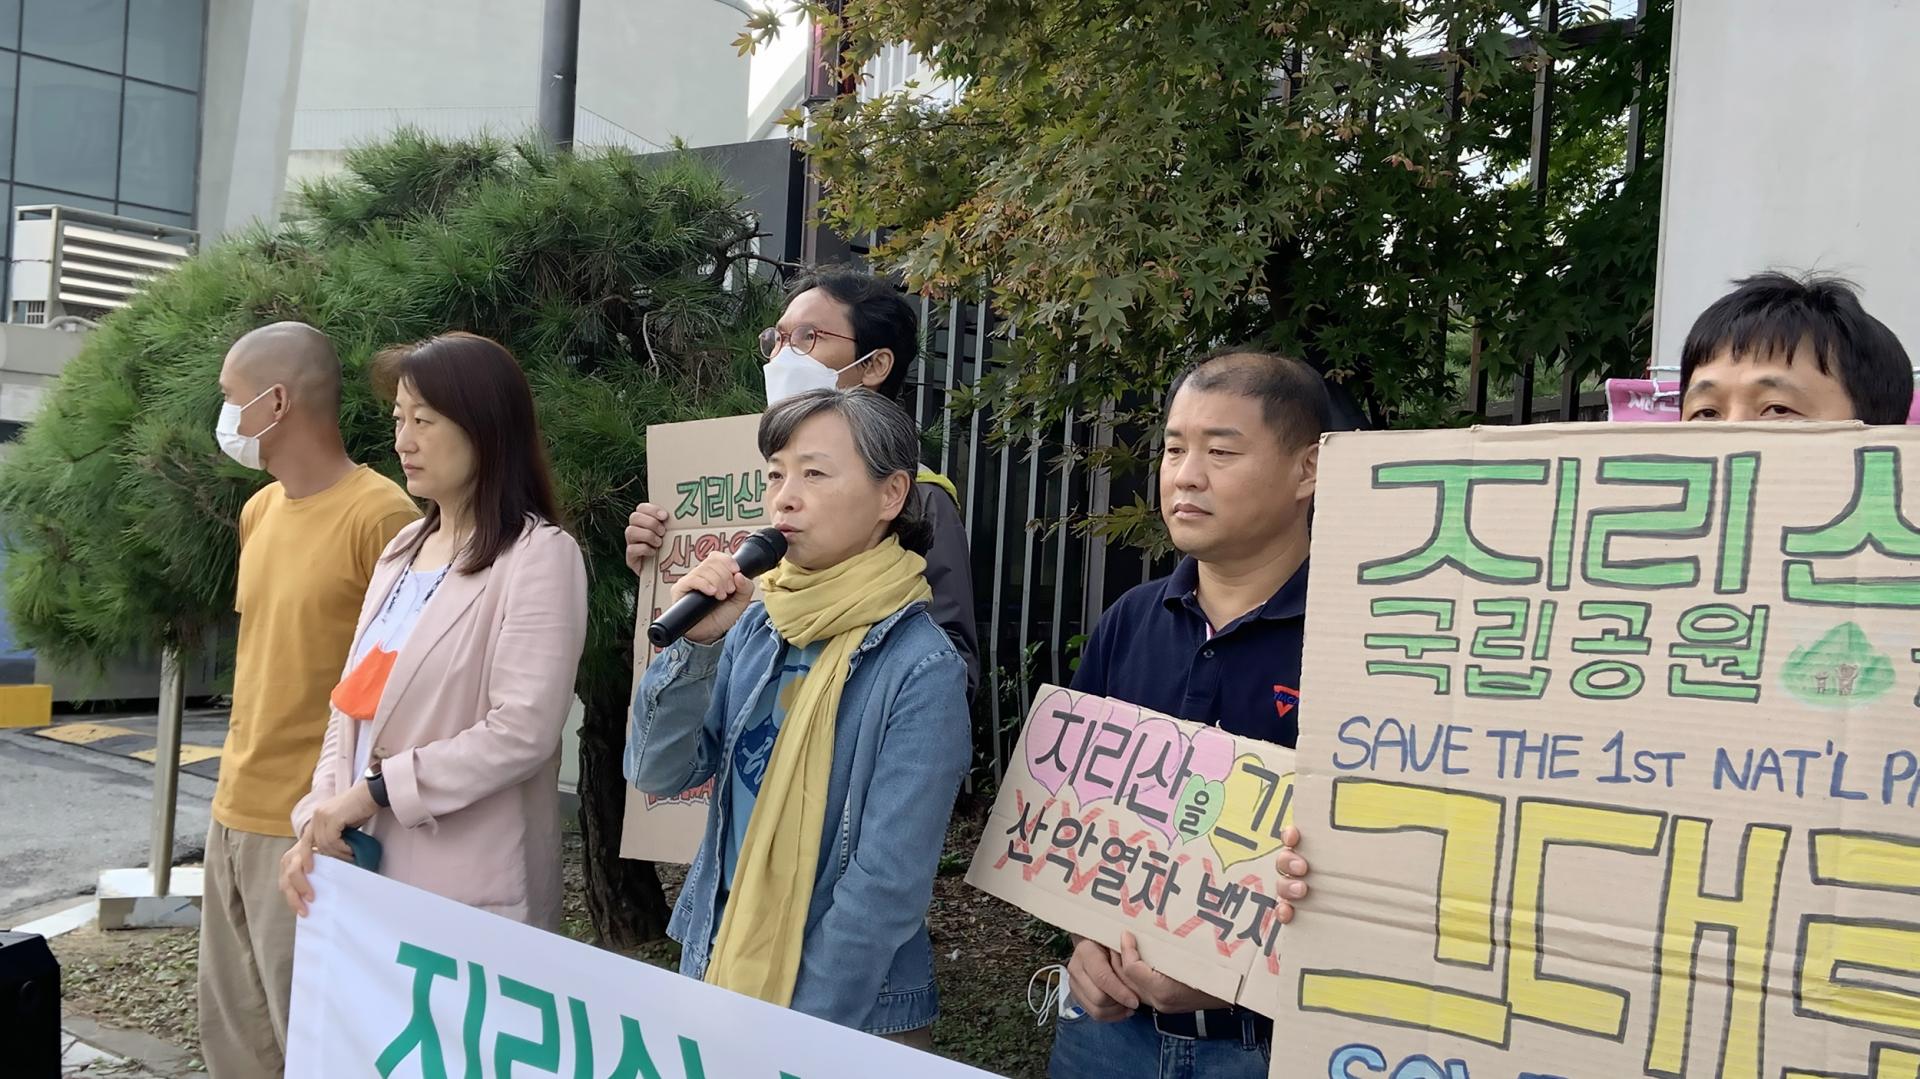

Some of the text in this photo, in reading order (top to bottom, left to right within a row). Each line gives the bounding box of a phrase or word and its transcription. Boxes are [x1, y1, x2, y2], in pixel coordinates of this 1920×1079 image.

[674, 468, 768, 526] 지리산
[1362, 596, 1771, 705] 국립공원
[1331, 715, 1473, 776] SAVE
[1486, 729, 1584, 780] THE
[1597, 730, 1686, 788] 1ST
[1713, 738, 1869, 800] NAT'L
[1005, 801, 1182, 916] 산악열차
